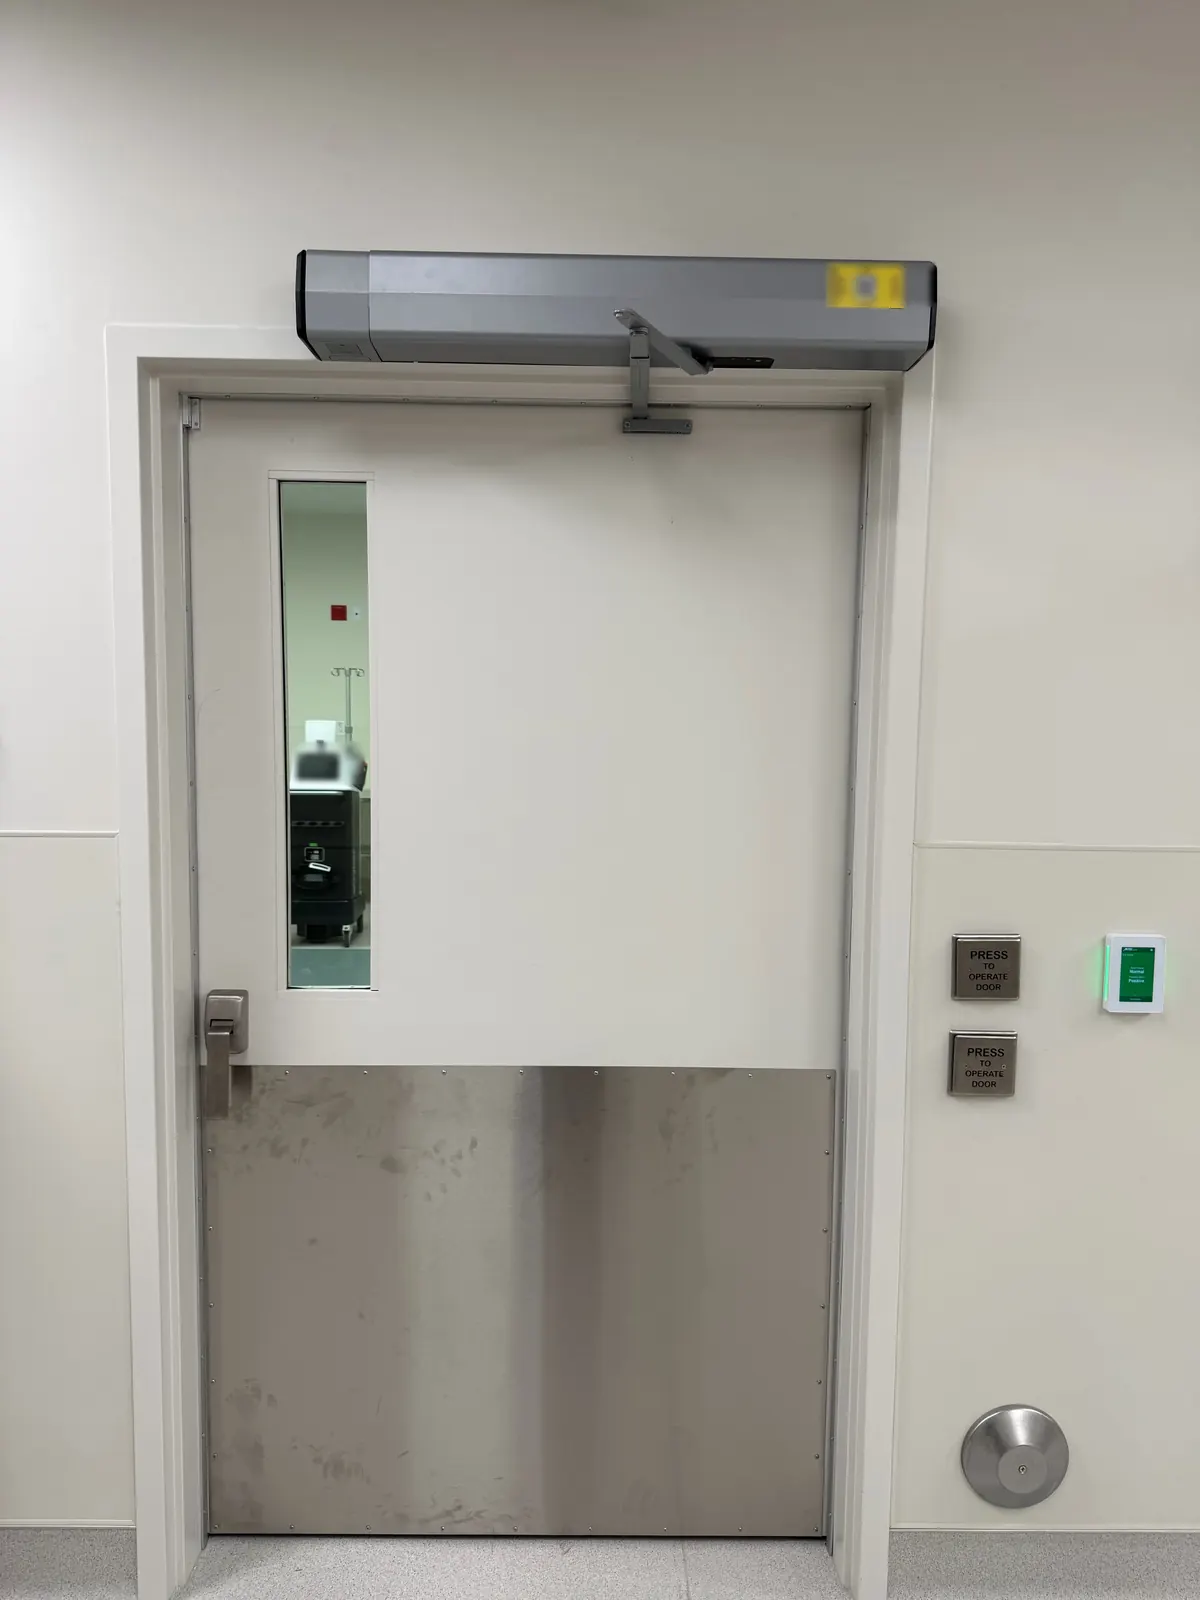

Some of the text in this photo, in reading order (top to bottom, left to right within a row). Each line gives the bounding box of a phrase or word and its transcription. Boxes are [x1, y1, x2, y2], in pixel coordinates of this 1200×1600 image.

[970, 950, 1009, 960] PRESS
[984, 962, 995, 970] TO
[968, 973, 1008, 981] OPERATE
[976, 983, 1001, 991] DOOR
[967, 1047, 1005, 1057] PRESS
[965, 1070, 1005, 1078] OPERATE
[971, 1080, 997, 1088] DOOR
